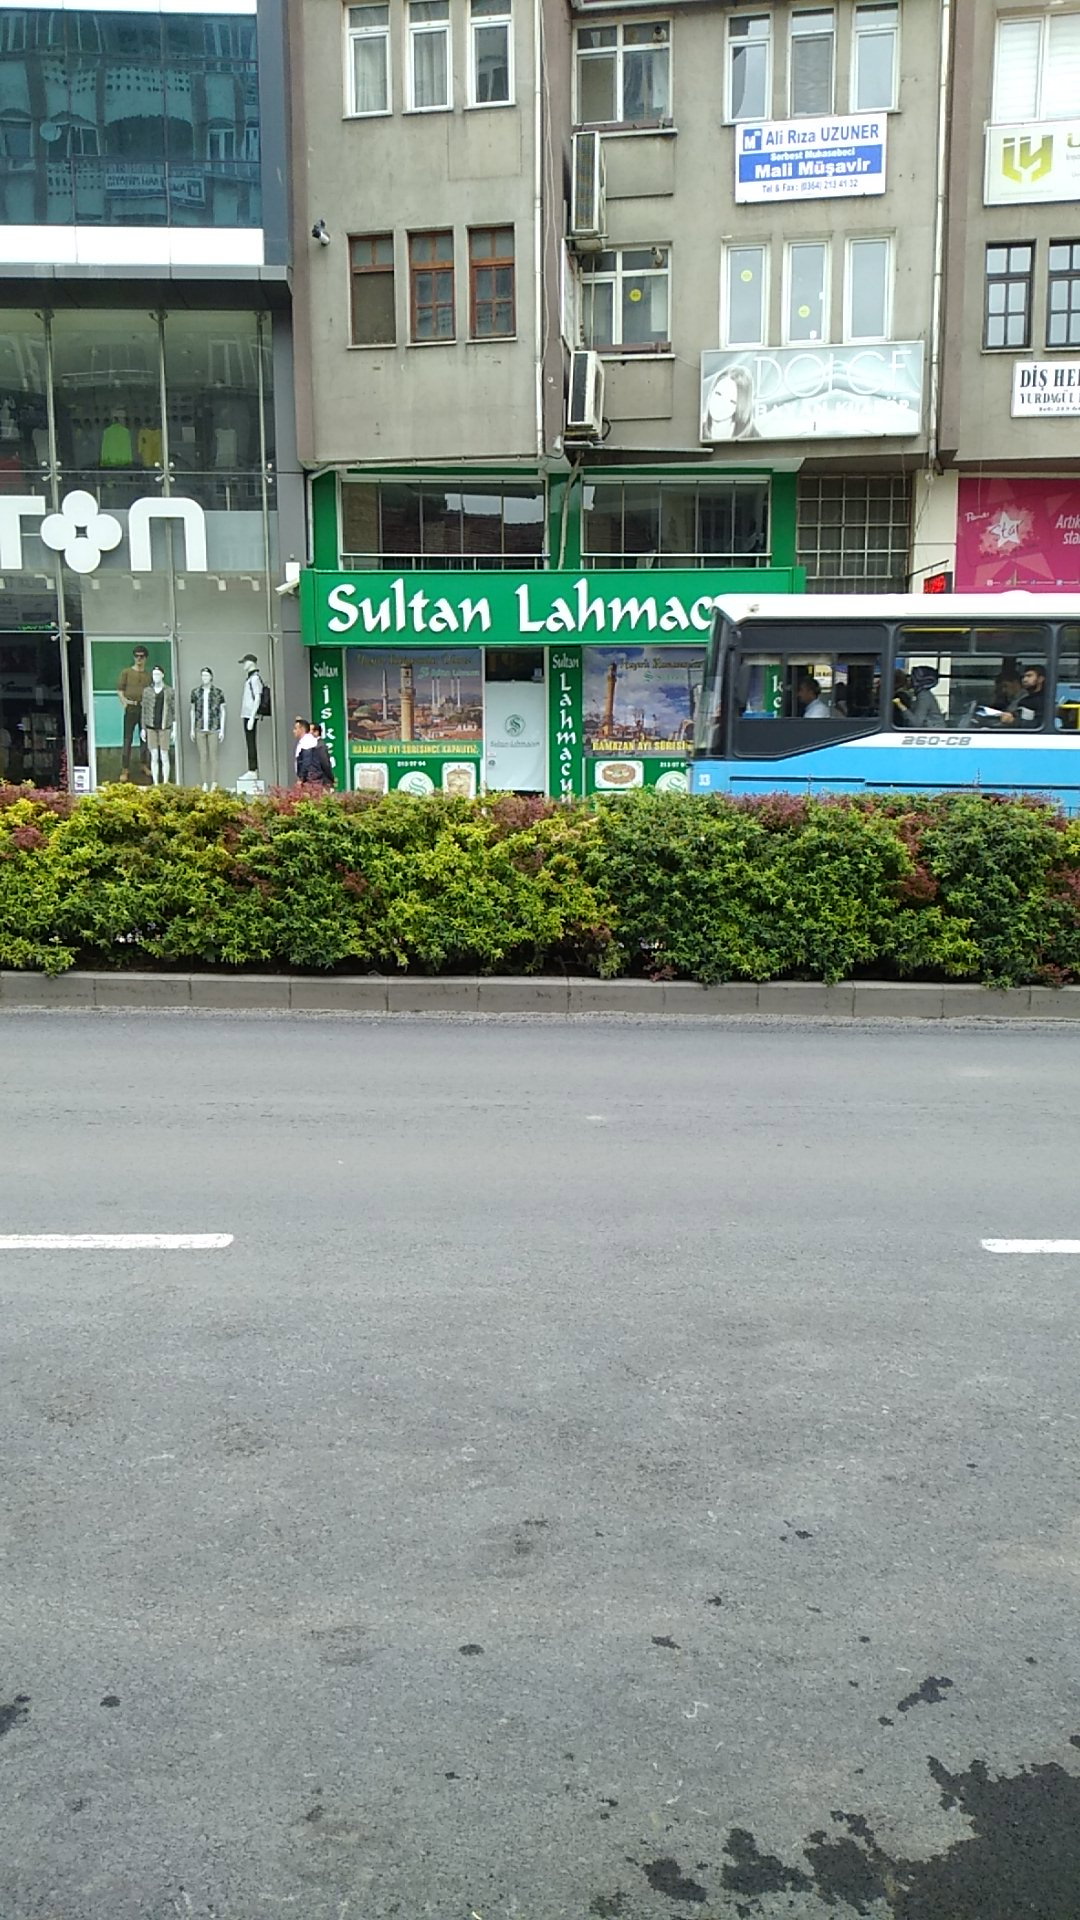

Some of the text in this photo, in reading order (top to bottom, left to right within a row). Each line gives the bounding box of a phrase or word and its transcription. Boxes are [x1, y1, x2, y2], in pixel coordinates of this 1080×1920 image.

[765, 123, 879, 146] Ali Rıza UZUNER
[755, 157, 871, 179] Mali Müşavir
[1020, 365, 1048, 391] DİŞ
[327, 578, 491, 632] Sultan
[313, 661, 338, 678] Sultan
[552, 653, 579, 669] Sultan
